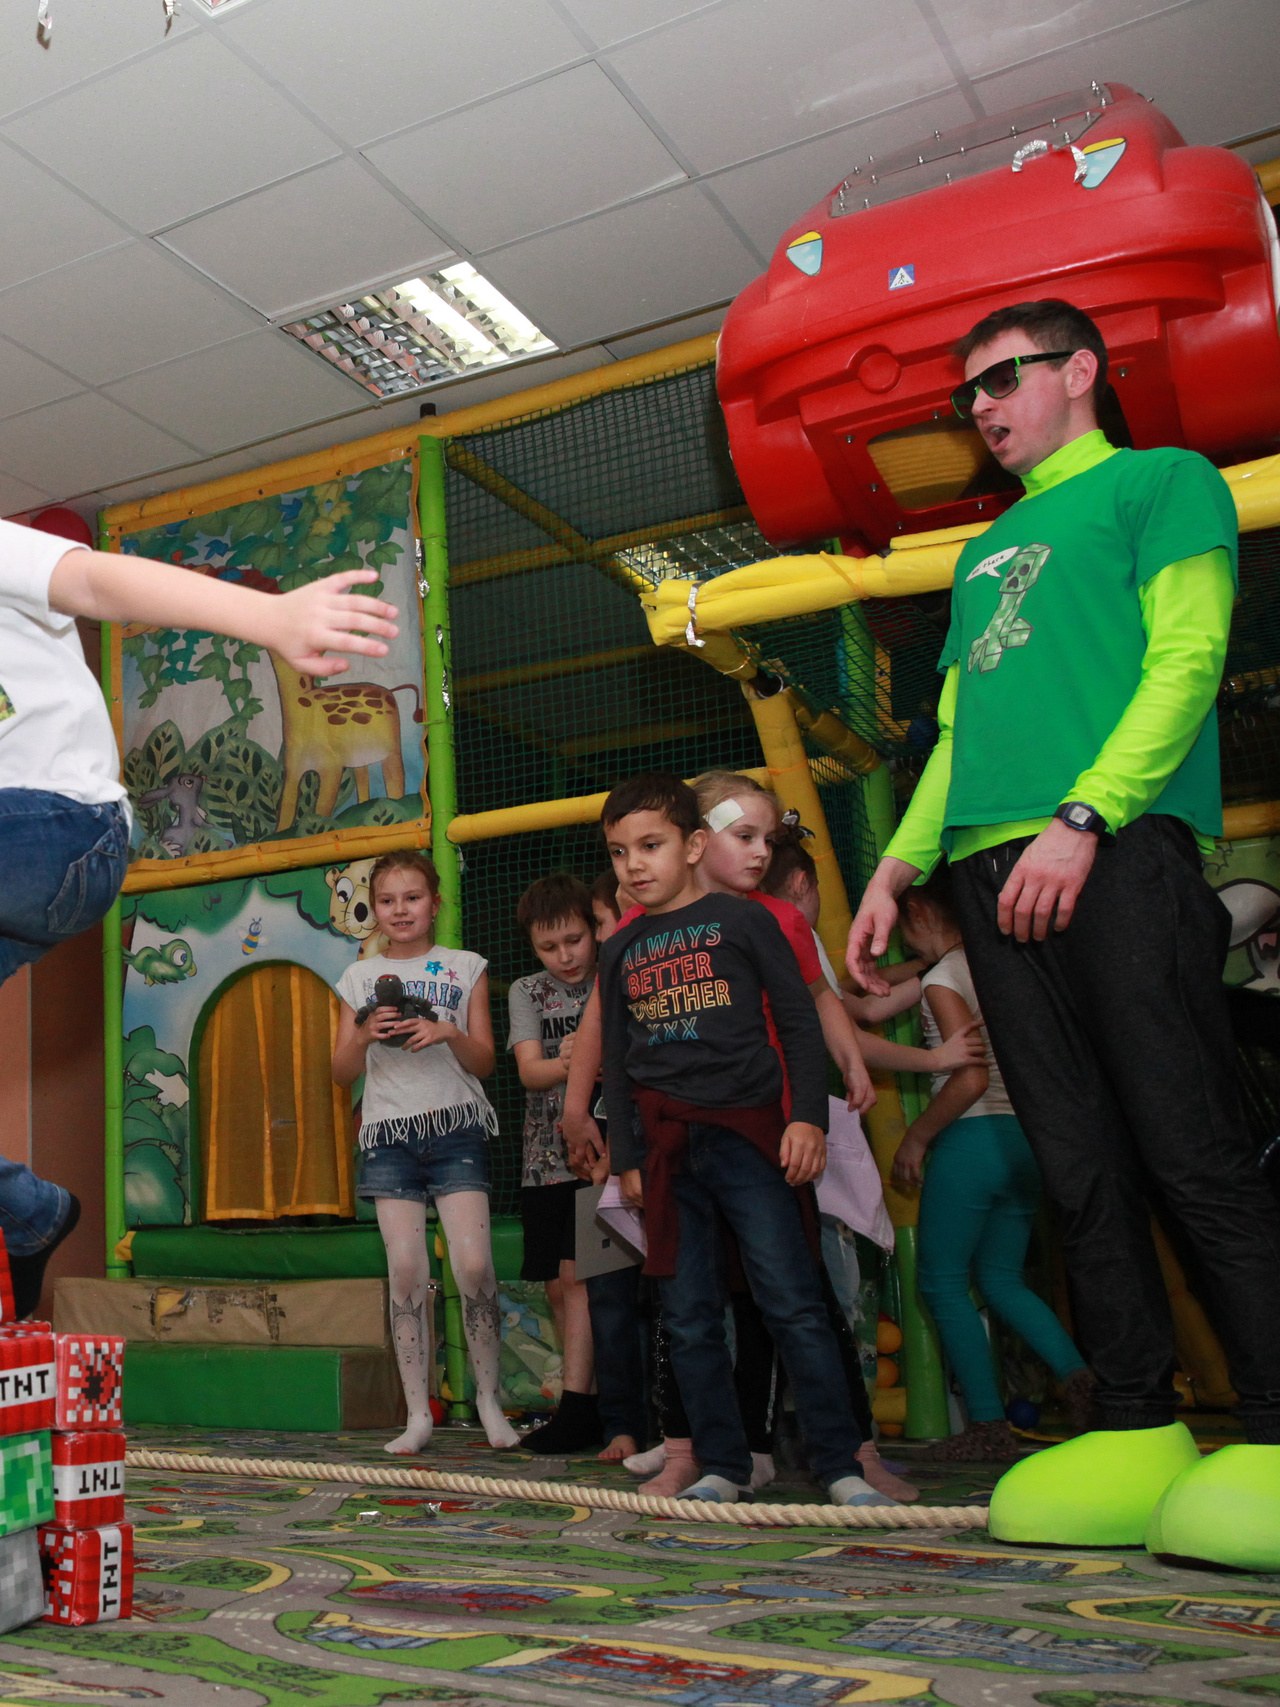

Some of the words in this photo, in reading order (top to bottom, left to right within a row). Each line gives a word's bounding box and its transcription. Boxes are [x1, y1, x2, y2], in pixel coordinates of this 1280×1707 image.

[621, 923, 721, 975] ALWAYS
[628, 952, 714, 999] BETTER
[628, 980, 731, 1022] TOGETHER
[79, 1467, 121, 1494] TNT
[102, 1542, 118, 1612] TNT
